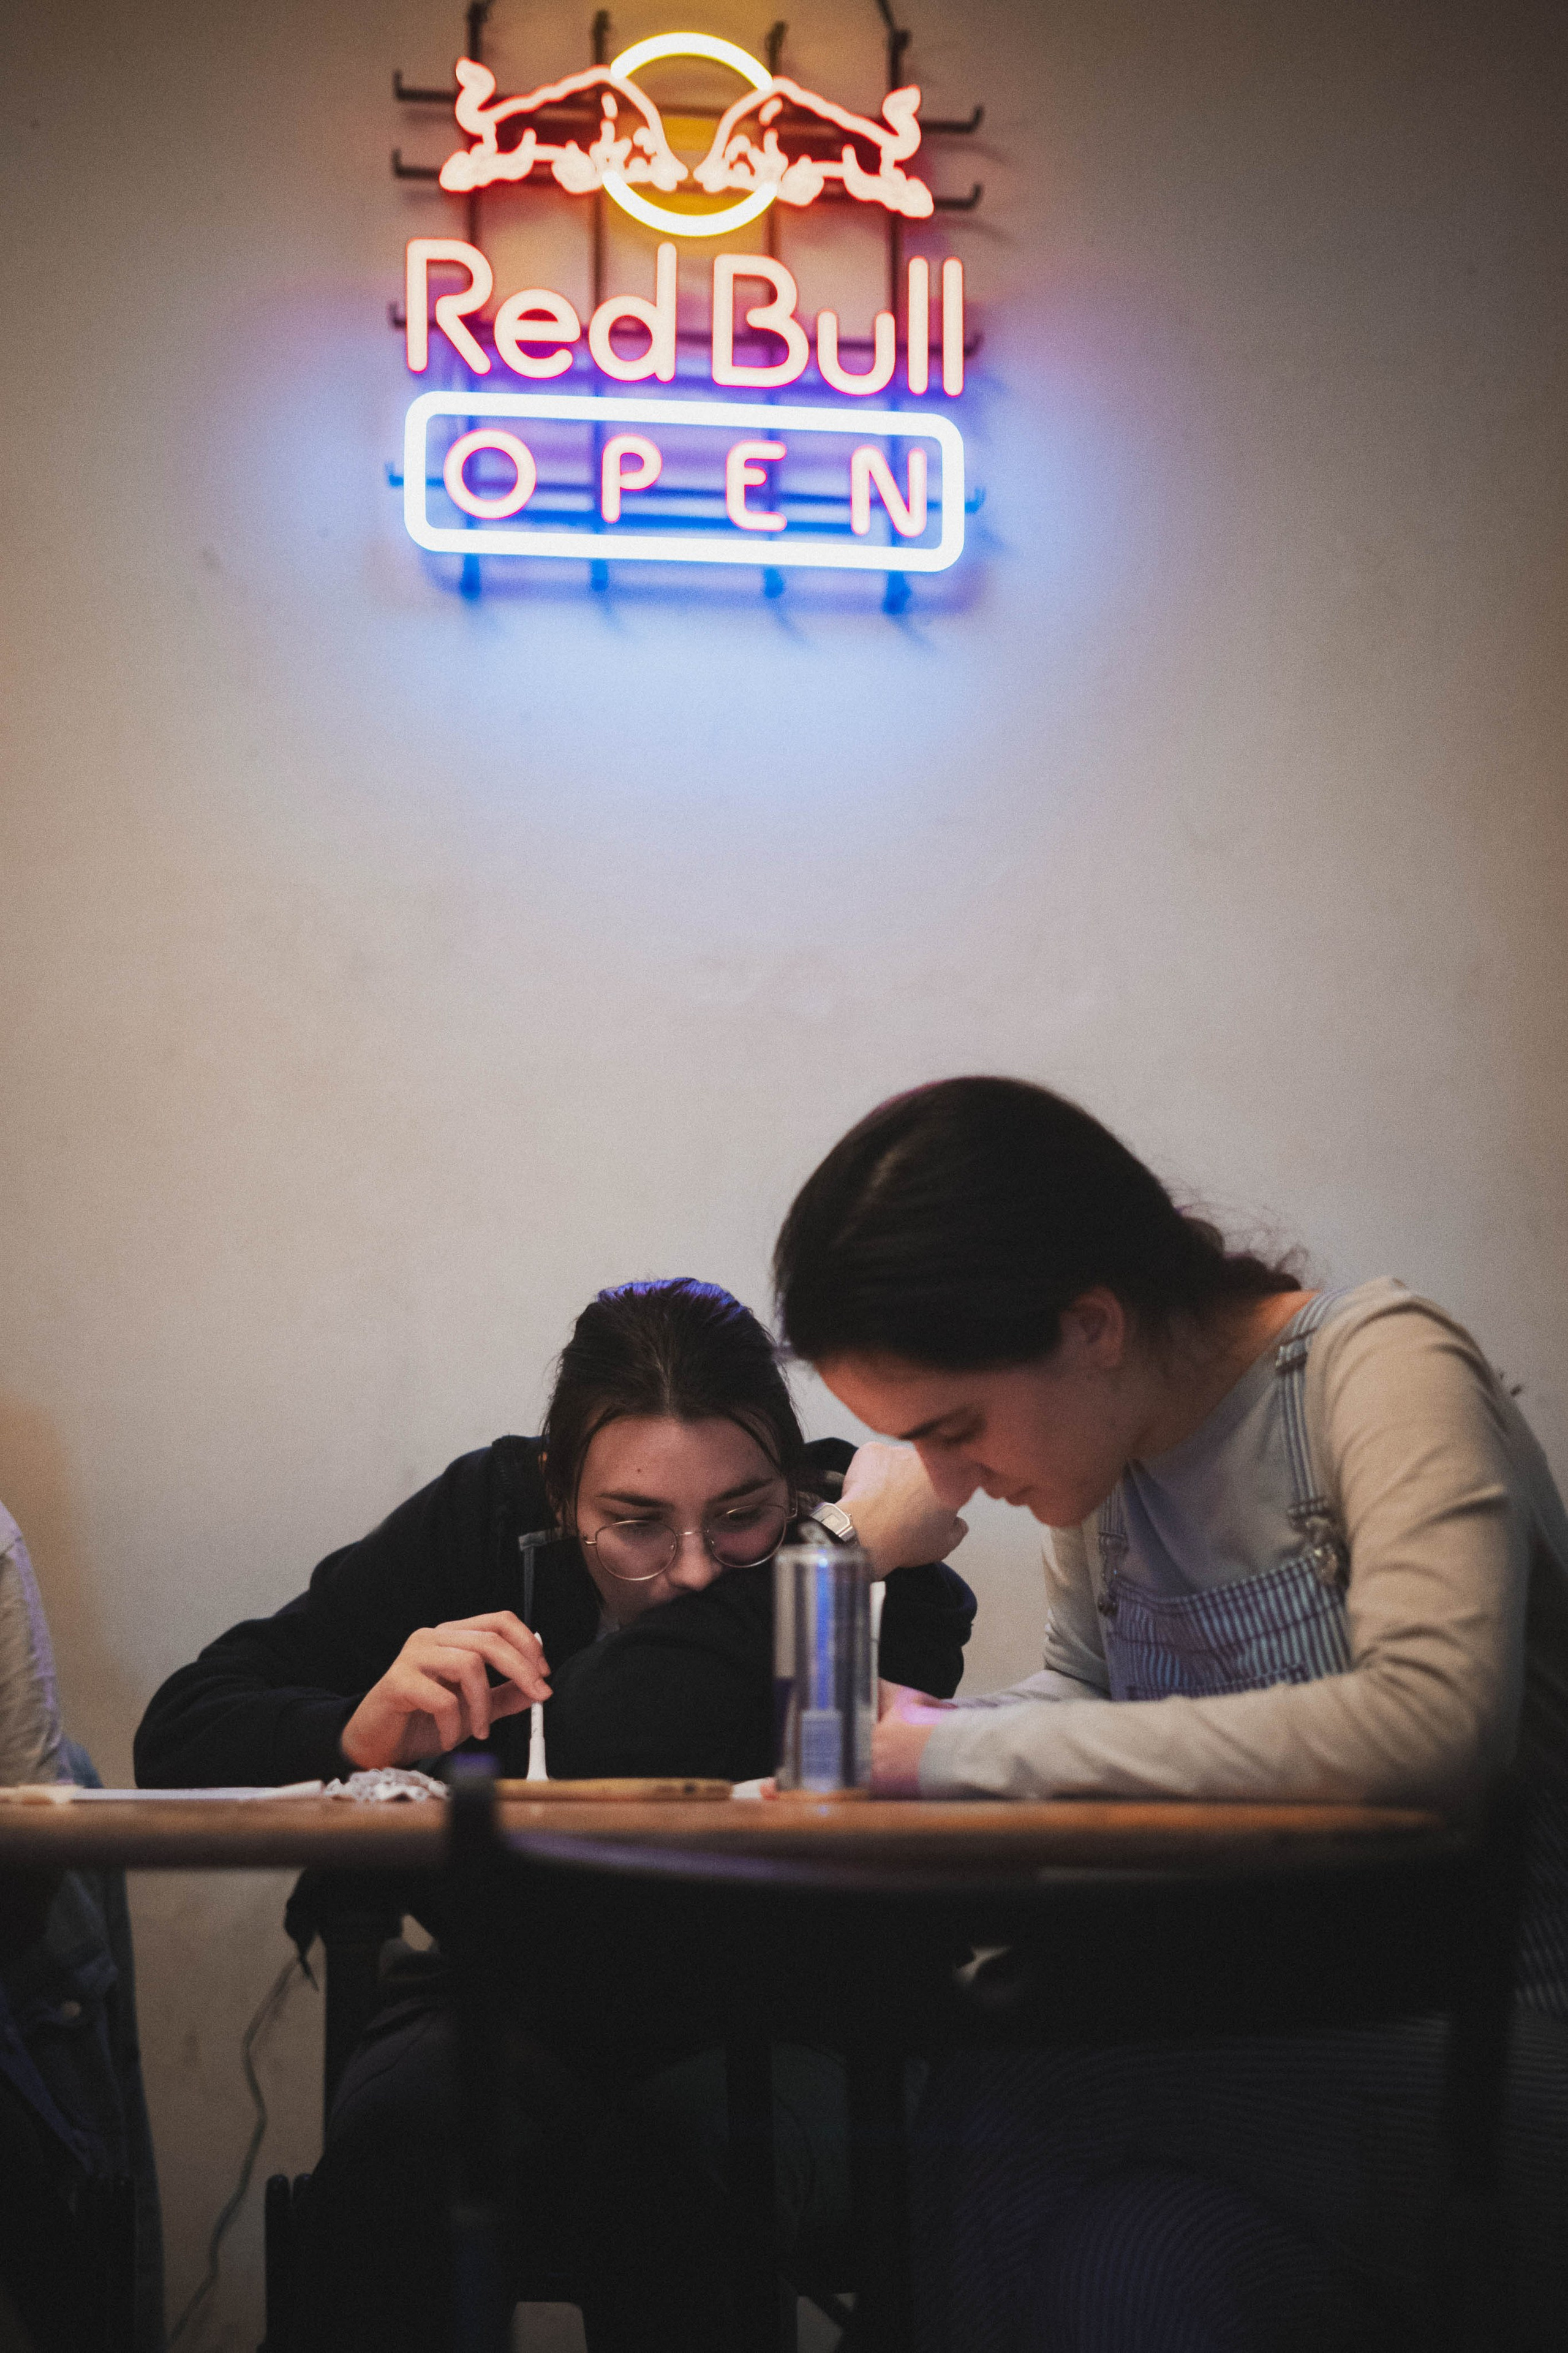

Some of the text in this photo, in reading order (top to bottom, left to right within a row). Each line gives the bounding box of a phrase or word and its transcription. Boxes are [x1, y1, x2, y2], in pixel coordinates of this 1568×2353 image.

[407, 238, 963, 396] Red Bull
[443, 428, 927, 537] OPEN
